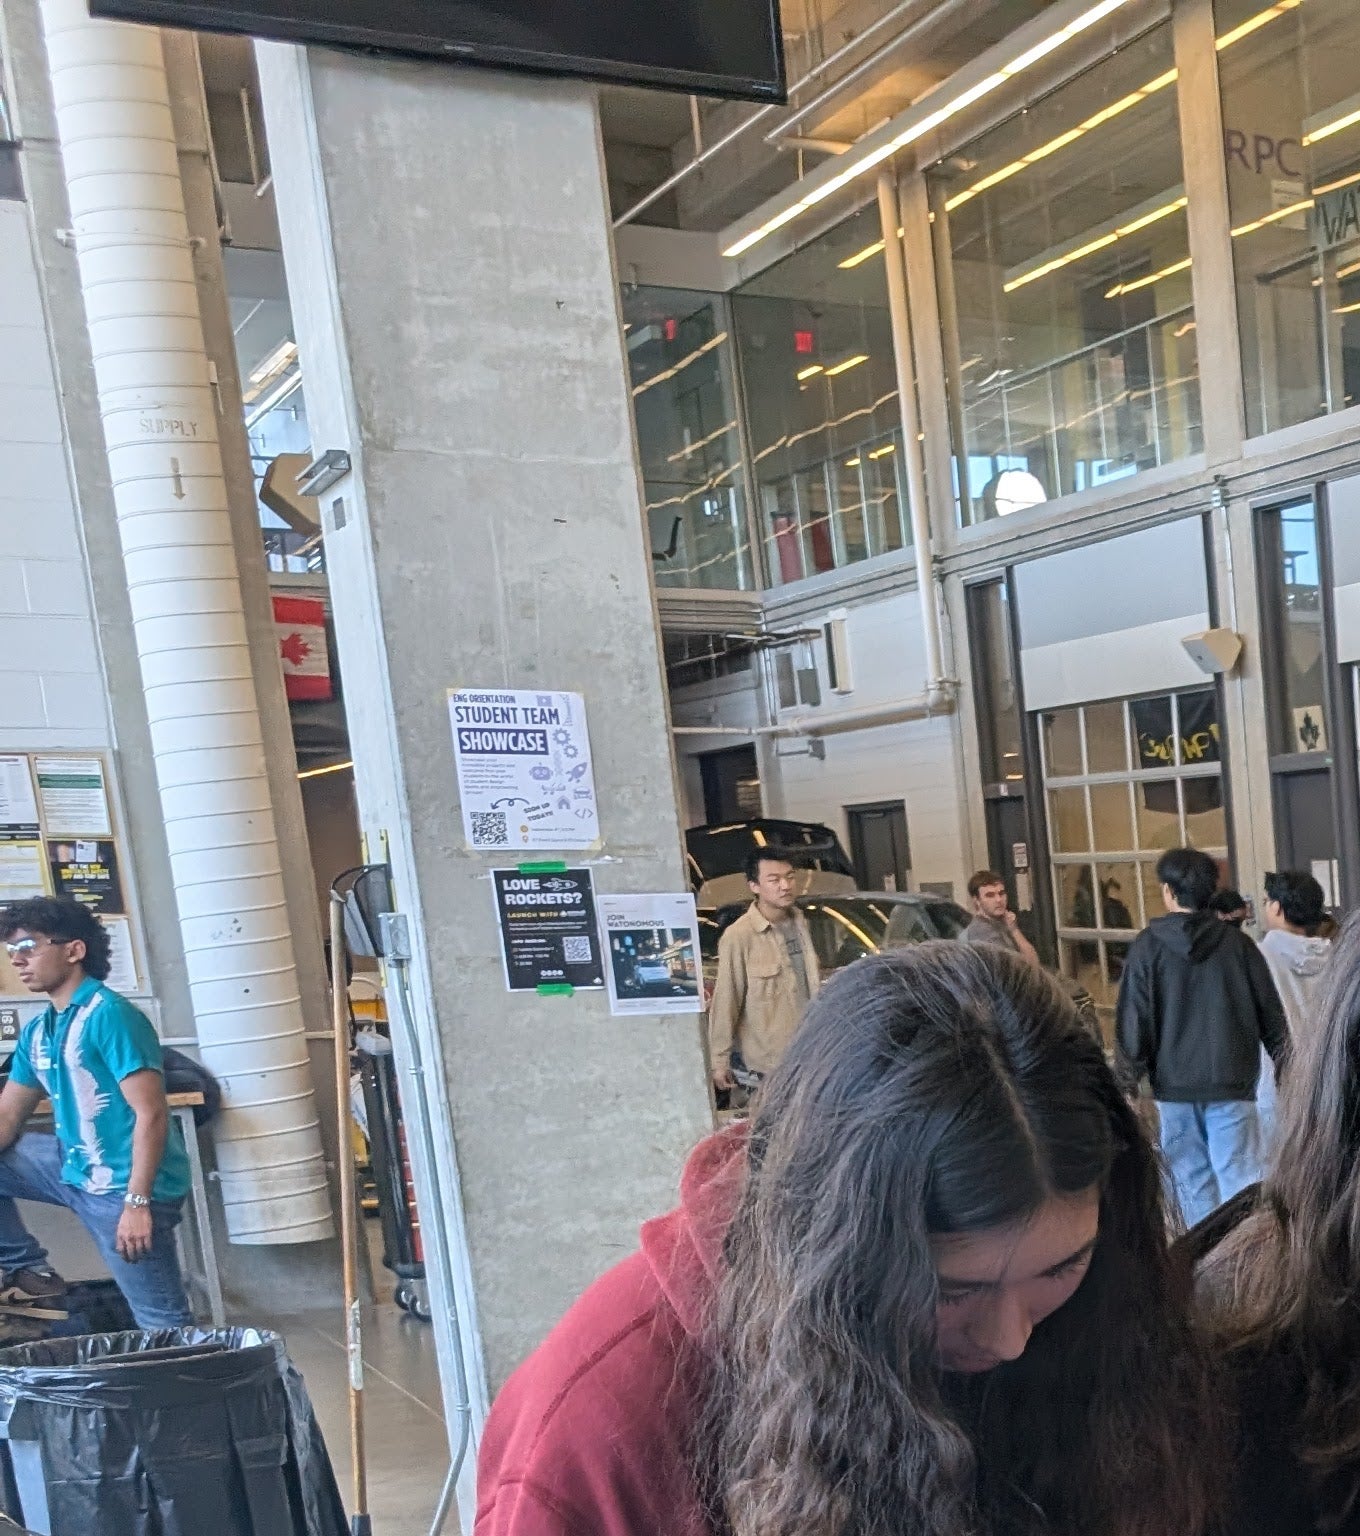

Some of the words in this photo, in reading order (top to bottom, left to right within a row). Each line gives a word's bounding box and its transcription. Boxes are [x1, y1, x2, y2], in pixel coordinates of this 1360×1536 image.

[139, 418, 198, 437] SUPPLY
[455, 705, 518, 724] STUDENT
[521, 707, 560, 725] TEAM
[460, 731, 546, 751] SHOWCASE
[502, 879, 541, 890] LOVE
[505, 892, 583, 905] ROCKETS?
